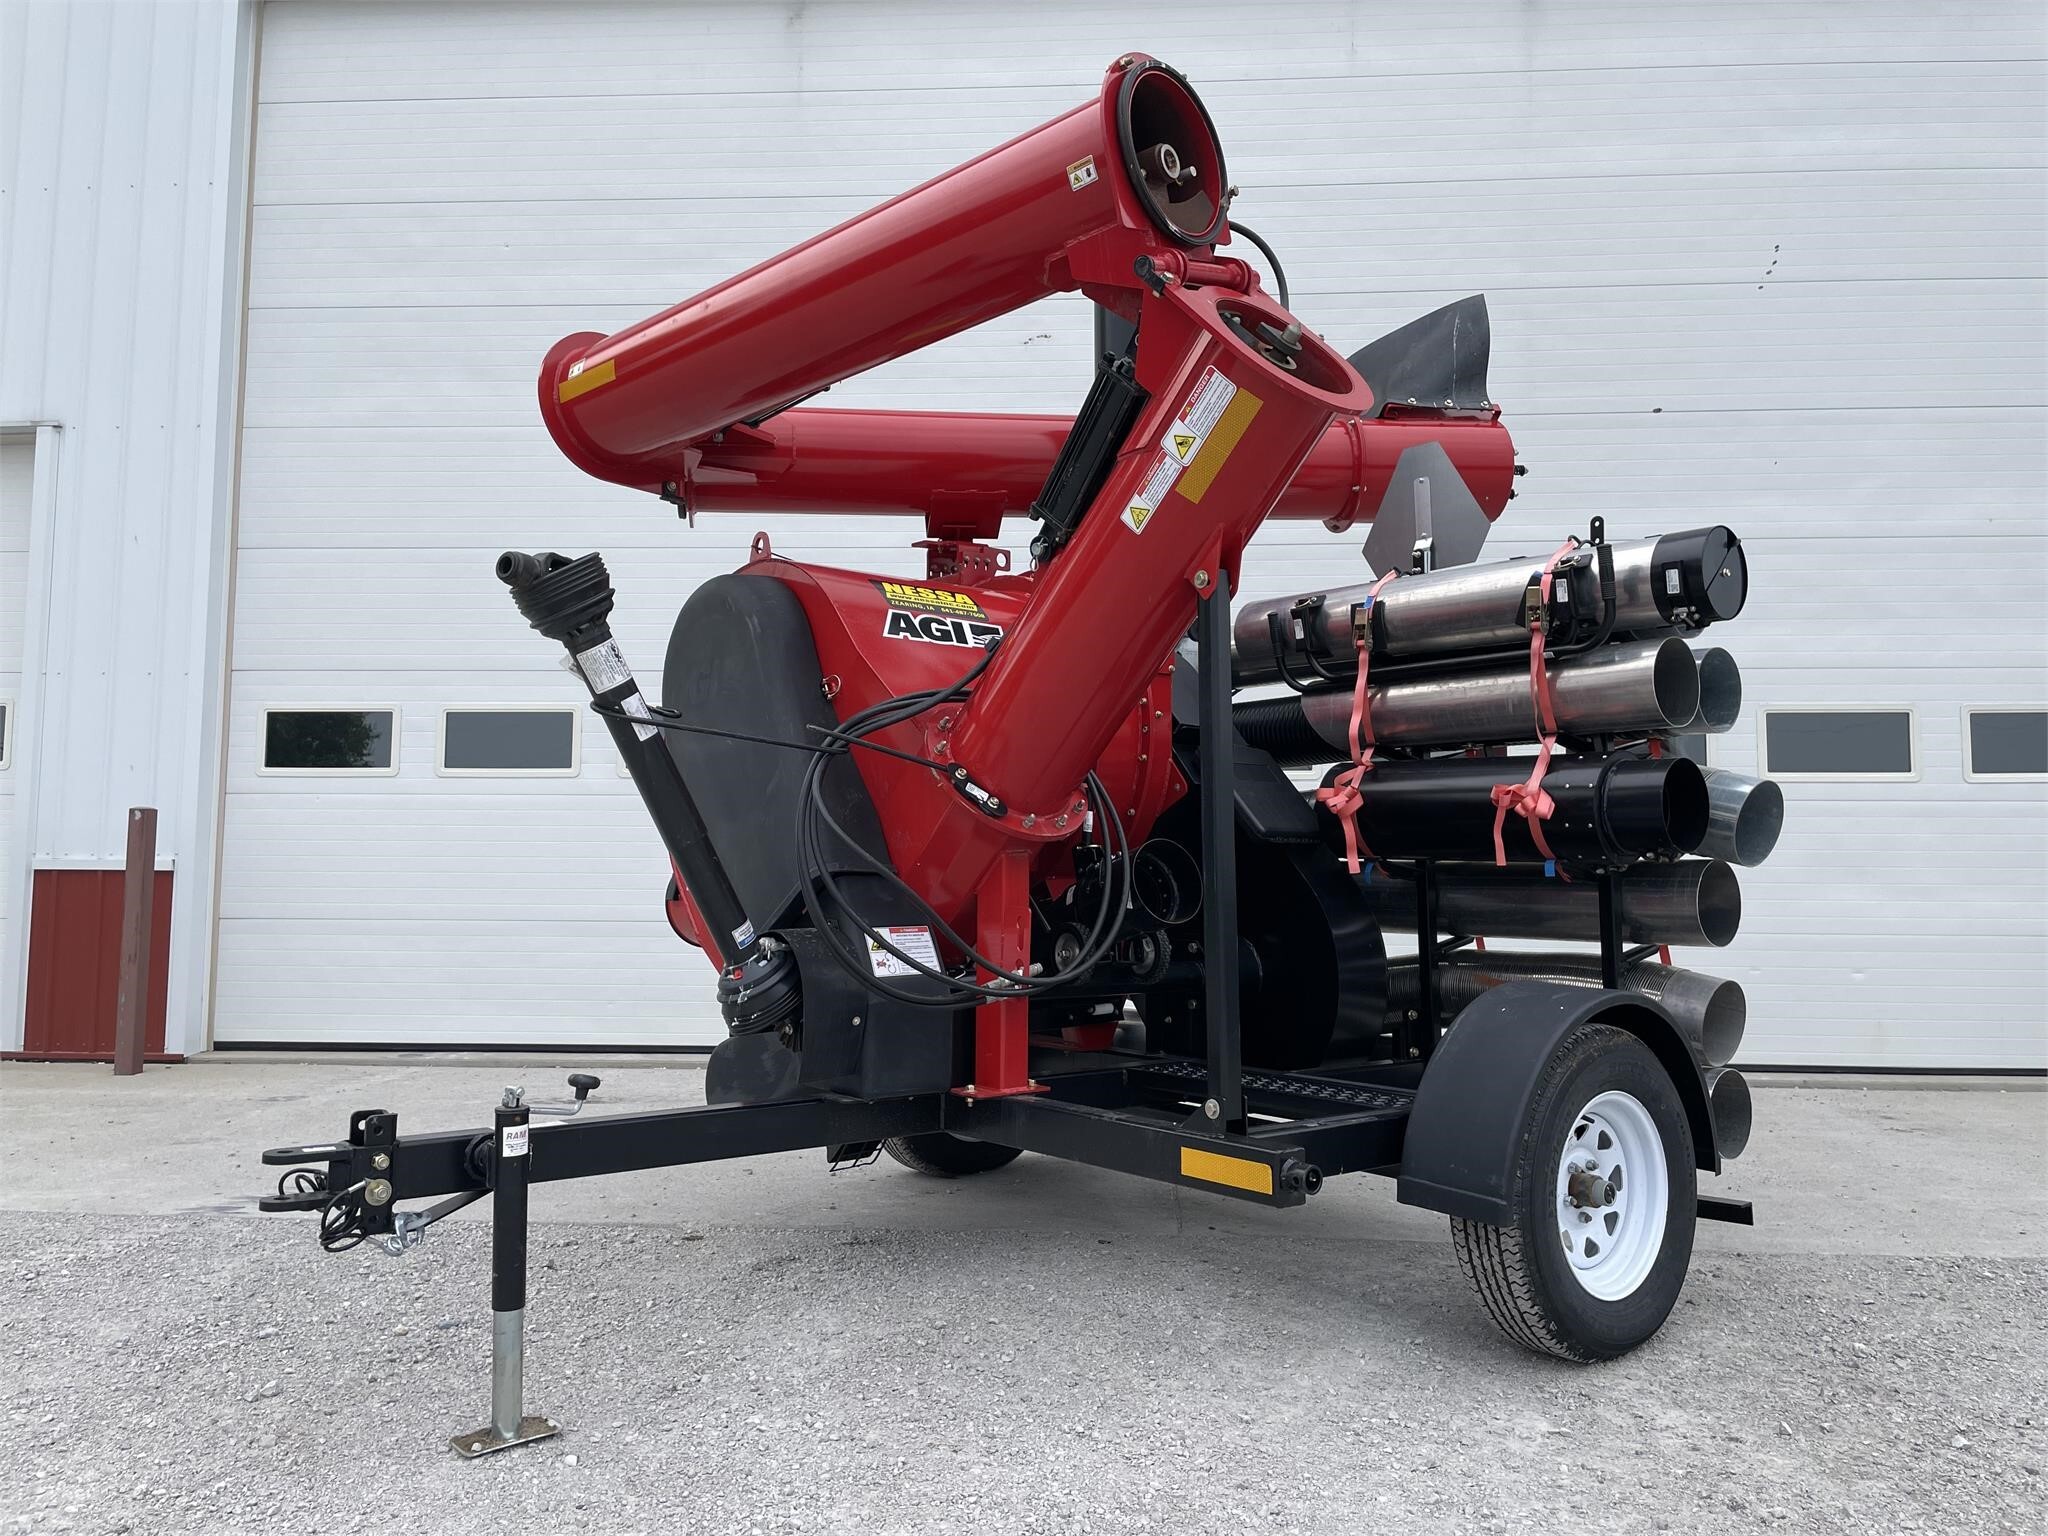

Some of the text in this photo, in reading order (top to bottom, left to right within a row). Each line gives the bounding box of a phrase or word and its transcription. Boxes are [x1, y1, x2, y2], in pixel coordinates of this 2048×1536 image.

[1190, 374, 1210, 403] DANGER
[881, 582, 976, 605] NESSA
[886, 611, 969, 645] AGI
[506, 1130, 527, 1140] RAM
